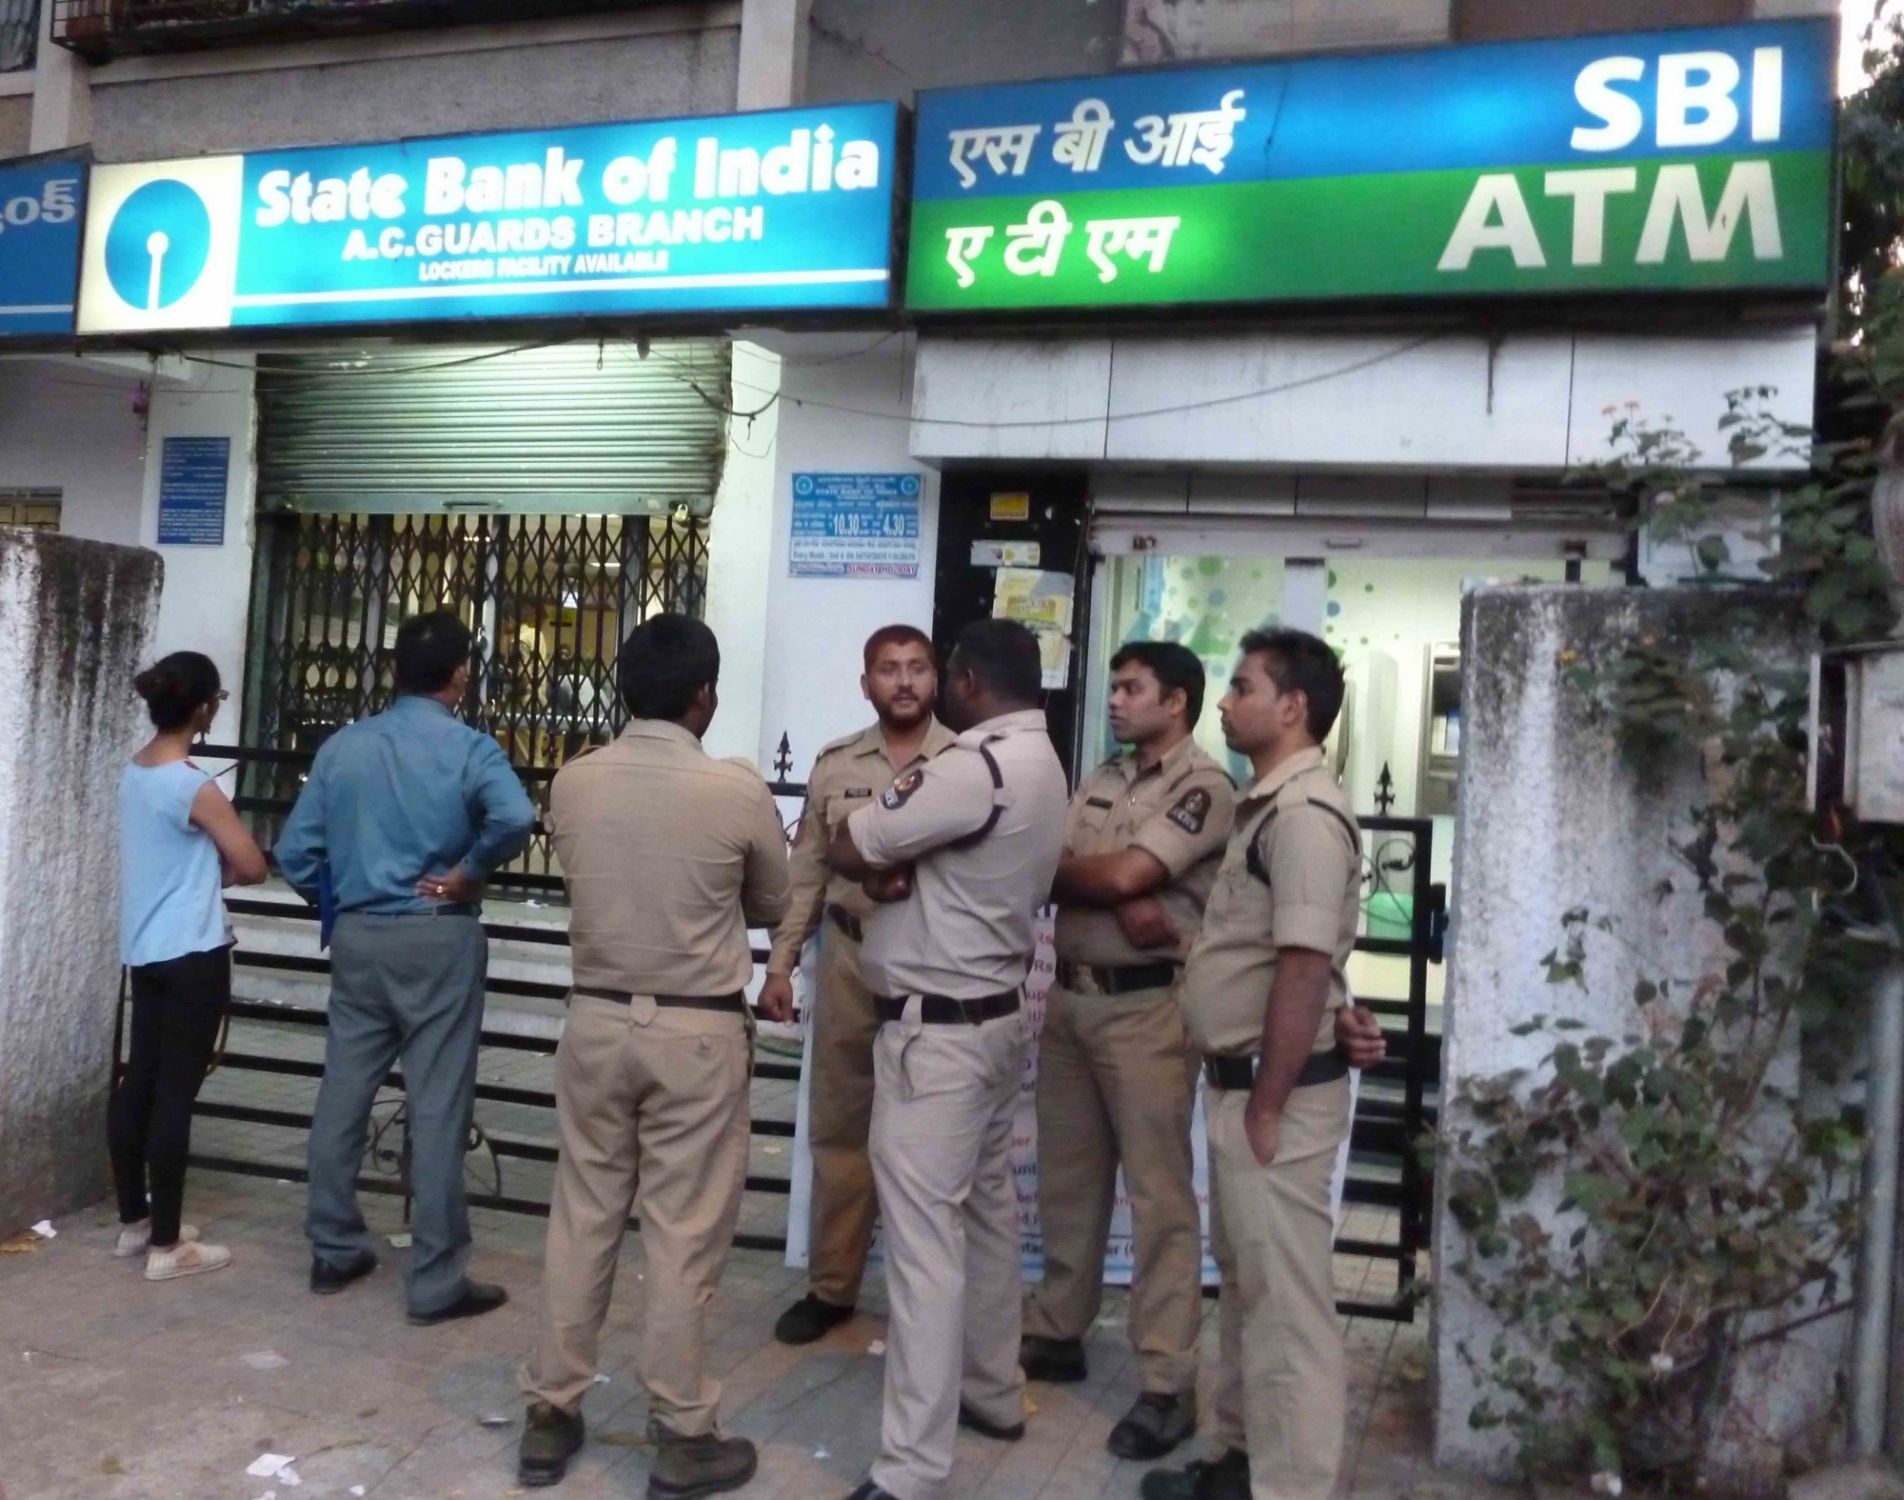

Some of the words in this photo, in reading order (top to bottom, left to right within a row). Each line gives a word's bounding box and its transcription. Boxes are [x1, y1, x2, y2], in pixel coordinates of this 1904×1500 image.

[948, 124, 1041, 188] एस
[1052, 98, 1114, 173] बी
[1123, 89, 1247, 174] आई
[1569, 46, 1783, 152] SBI
[256, 166, 408, 228] State
[424, 147, 584, 215] Bank
[601, 137, 677, 205] of
[694, 123, 879, 200] India
[1436, 160, 1784, 272] ATM
[342, 215, 576, 261] A.C.GUARDS
[587, 206, 764, 248] BRANCH
[419, 258, 494, 282] LOCKERS
[573, 250, 670, 275] AVAILABLE
[945, 225, 994, 288] ए
[1003, 200, 1073, 277] टी
[1085, 216, 1181, 284] एम
